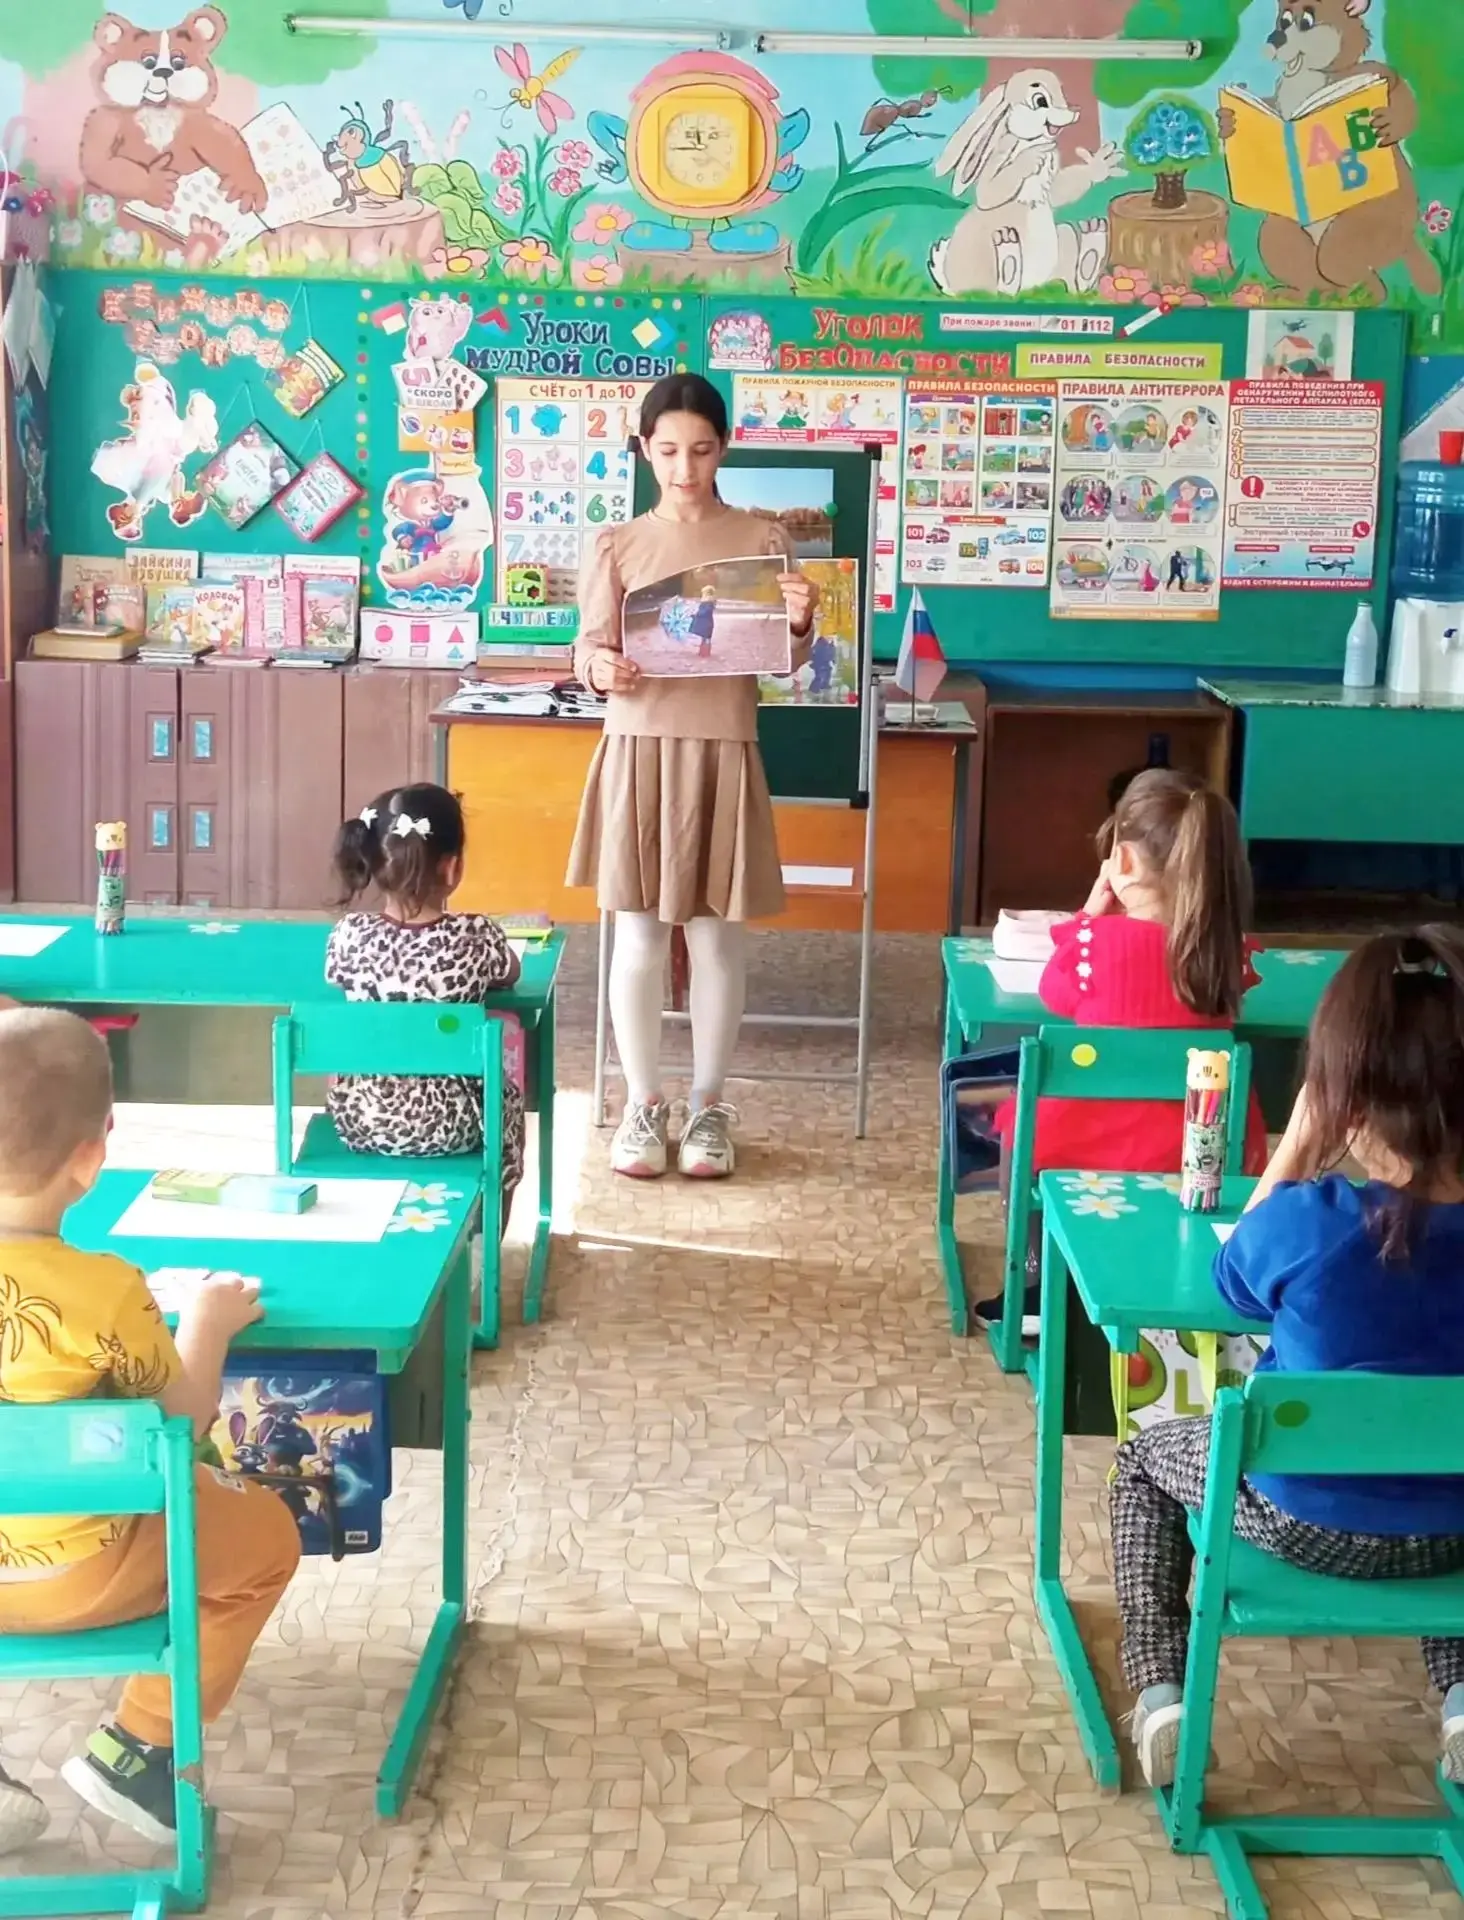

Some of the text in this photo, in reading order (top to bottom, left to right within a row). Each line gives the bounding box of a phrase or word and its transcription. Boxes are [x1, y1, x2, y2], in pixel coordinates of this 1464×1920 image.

[942, 316, 964, 328] При
[967, 318, 1001, 330] пожаре
[1060, 319, 1076, 331] 01
[1088, 319, 1111, 332] 112
[1030, 353, 1205, 368] ПРАВИЛА БЕЗОПАСНОСТИ
[742, 377, 896, 388] ПРАВИЛА ПОЖАРНОЙ БЕЗОПАСНОСТИ
[908, 380, 1056, 393] ПРАВИЛА БЕЗОПАСНОСТИ
[1062, 383, 1225, 396] ПРАВИЛА АНТИТЕРРОРА
[1292, 382, 1345, 390] ПОВЕДЕНИЯ
[413, 388, 452, 398] СКОРО
[530, 384, 565, 397] СЧЁТ
[585, 383, 593, 398] 1
[617, 384, 636, 398] 10
[1237, 389, 1376, 398] ОБНАРУЖЕНИИ БЕСПИЛОТНОГО
[1233, 396, 1299, 405] ЛЕТАТЕЛЬНОГО
[1302, 397, 1348, 405] АППАРАТА
[505, 405, 520, 435] 1
[587, 408, 607, 438] 2
[1231, 428, 1242, 445] 2
[1231, 445, 1242, 463] 3
[504, 448, 525, 478] 3
[586, 450, 608, 480] 4
[1230, 463, 1242, 480] 4
[504, 491, 524, 521] 5
[586, 494, 607, 523] 6
[907, 528, 923, 537] 101
[1028, 530, 1046, 540] 102
[504, 533, 525, 563] 7
[128, 553, 192, 569] ЗАЙКИНА
[905, 559, 922, 568] 103
[1027, 562, 1044, 572] 104
[130, 568, 190, 582] ИЗБУШКА
[196, 591, 241, 605] КОЛОБОК
